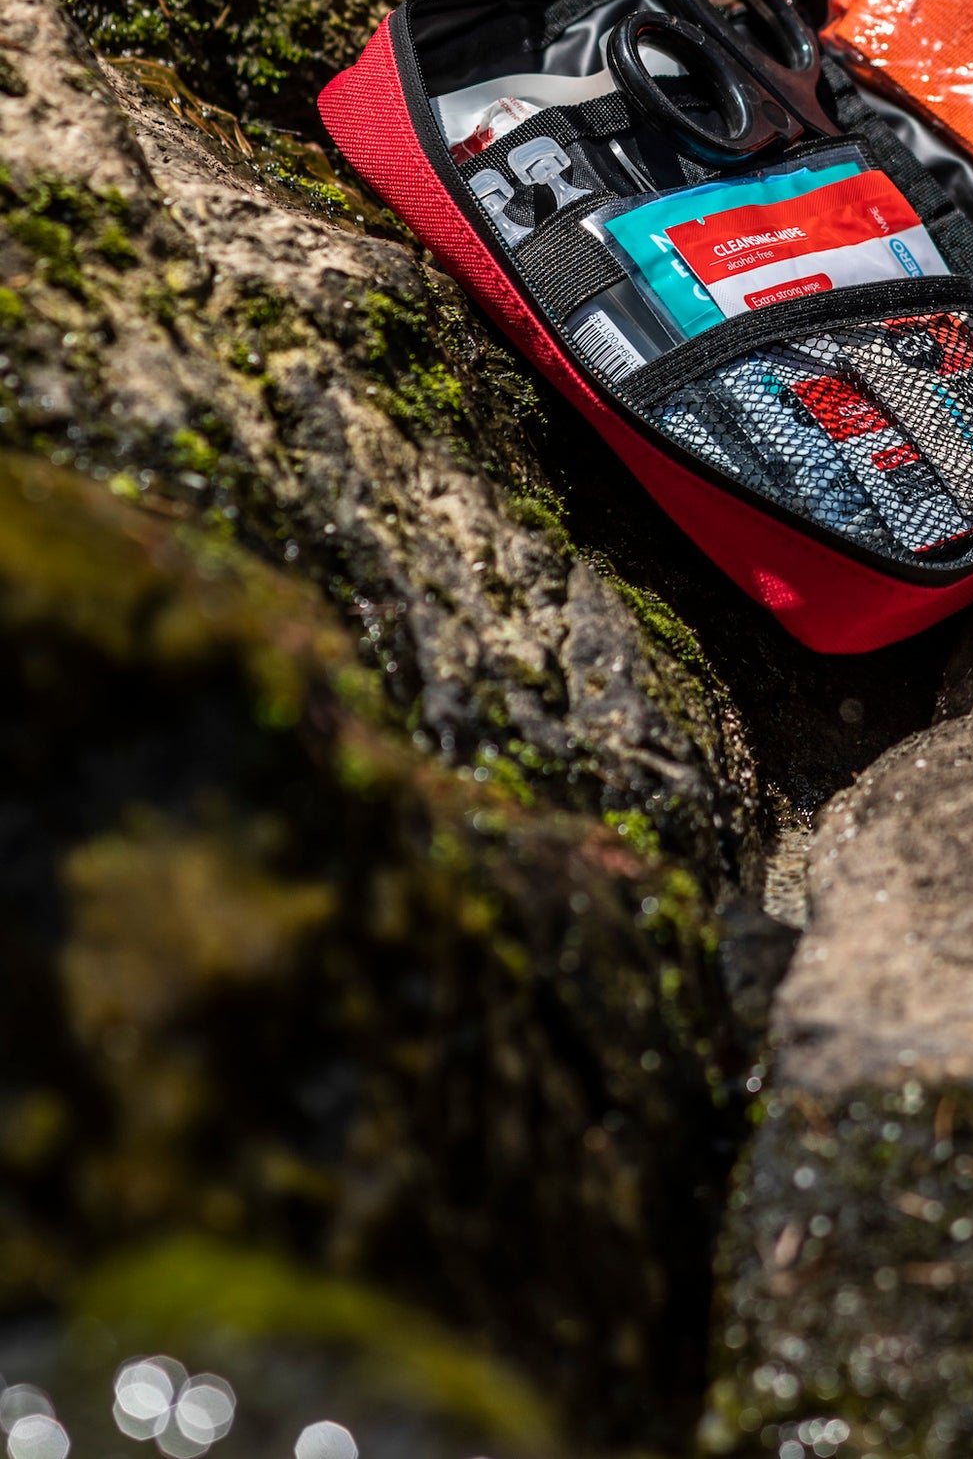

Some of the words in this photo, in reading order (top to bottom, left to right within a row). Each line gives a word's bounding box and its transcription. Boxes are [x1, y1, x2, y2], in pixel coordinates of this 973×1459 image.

[713, 233, 778, 257] CLEANSING
[773, 226, 807, 241] WIPE
[726, 250, 775, 271] alcohol-free
[750, 292, 777, 308] Extra
[775, 285, 804, 300] strong
[801, 281, 822, 294] wipe
